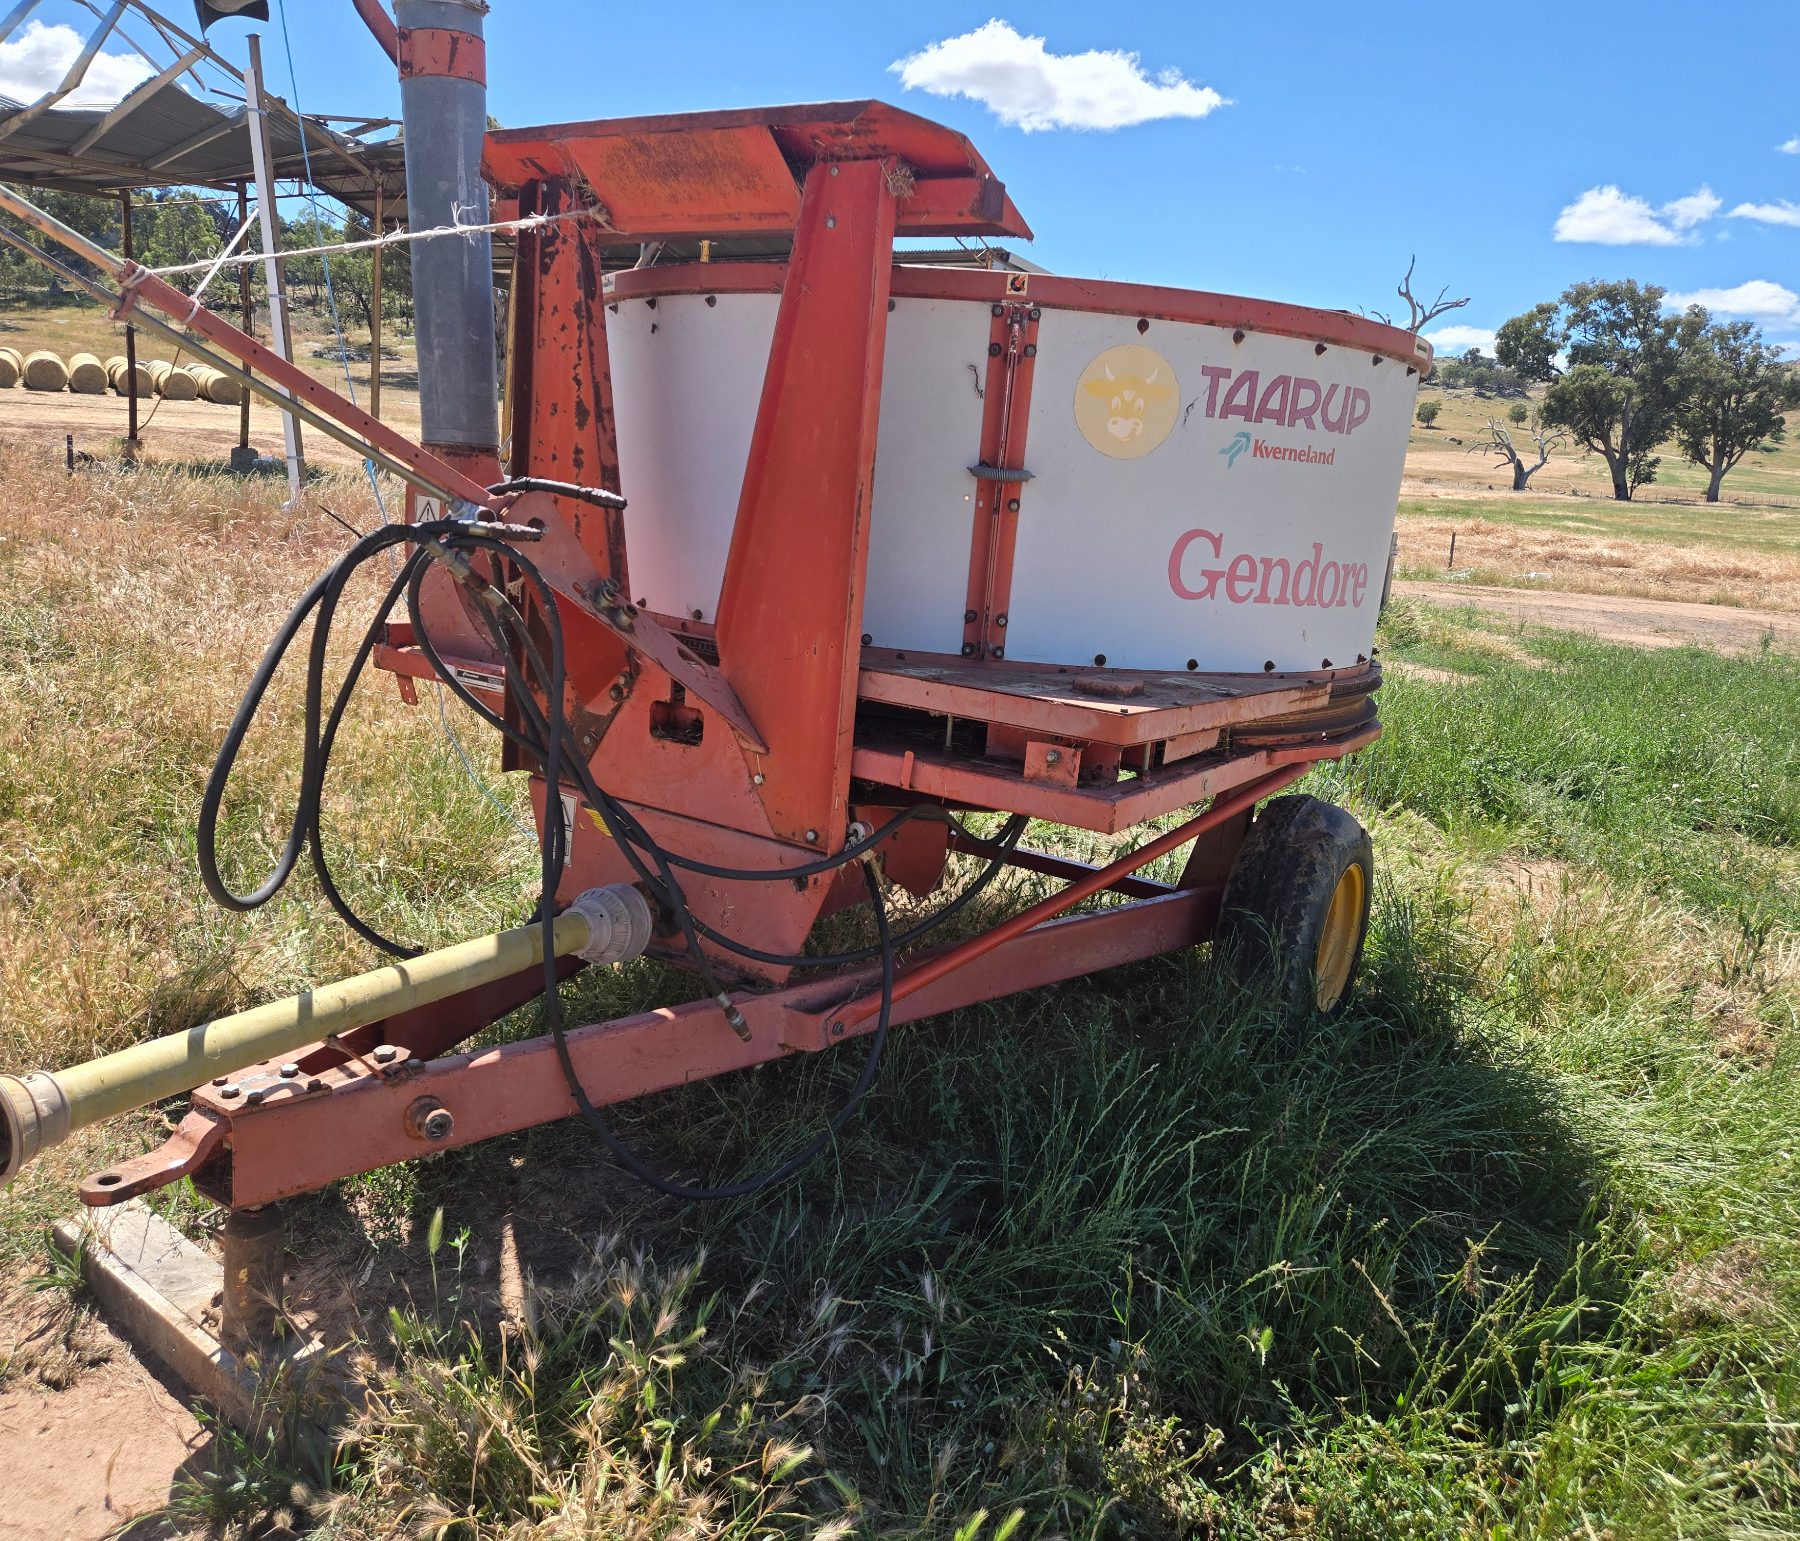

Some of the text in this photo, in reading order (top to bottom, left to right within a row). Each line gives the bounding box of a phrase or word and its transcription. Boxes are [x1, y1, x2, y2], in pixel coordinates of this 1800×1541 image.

[1202, 365, 1370, 435] TAARUP
[1252, 438, 1335, 465] Kverneland
[1168, 528, 1368, 609] Gendore
